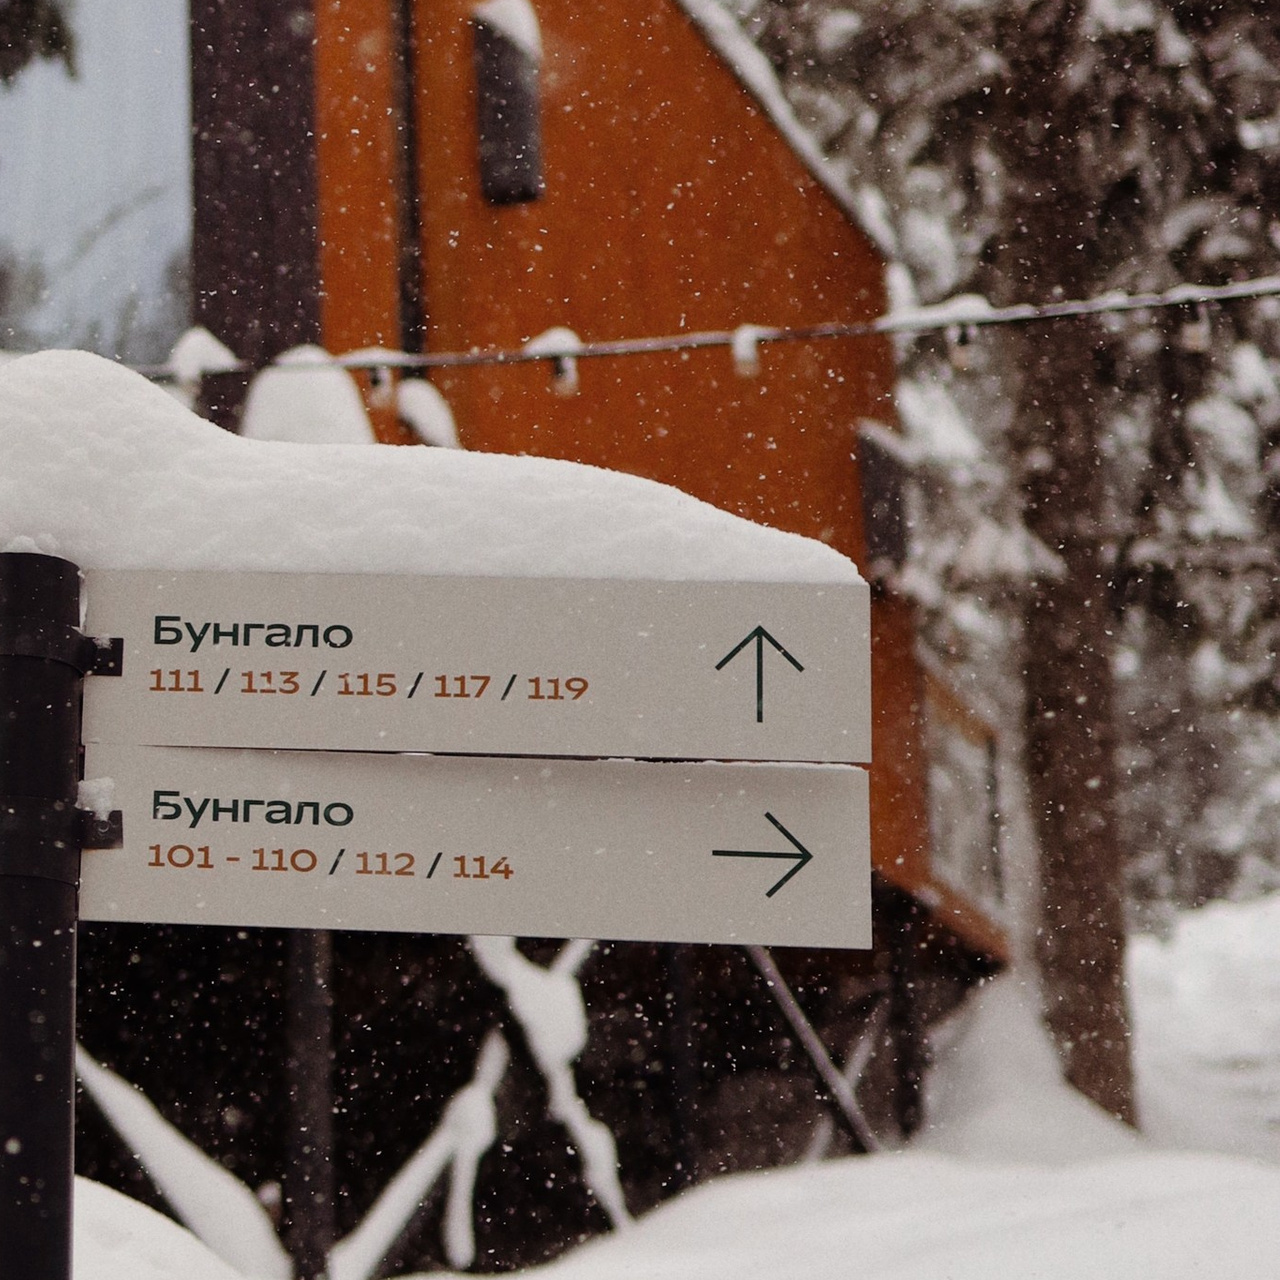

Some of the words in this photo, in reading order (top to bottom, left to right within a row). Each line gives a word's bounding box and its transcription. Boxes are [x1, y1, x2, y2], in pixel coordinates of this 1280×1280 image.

[153, 615, 354, 654] Бунгало
[148, 668, 205, 693] 111
[240, 670, 300, 695] 113
[337, 672, 397, 697] 115
[433, 674, 491, 699] 117
[527, 676, 589, 701] 119
[152, 789, 355, 829] Бунгало
[147, 843, 215, 869] 101
[251, 847, 318, 873] 110
[355, 851, 416, 877] 112
[453, 854, 515, 880] 114
